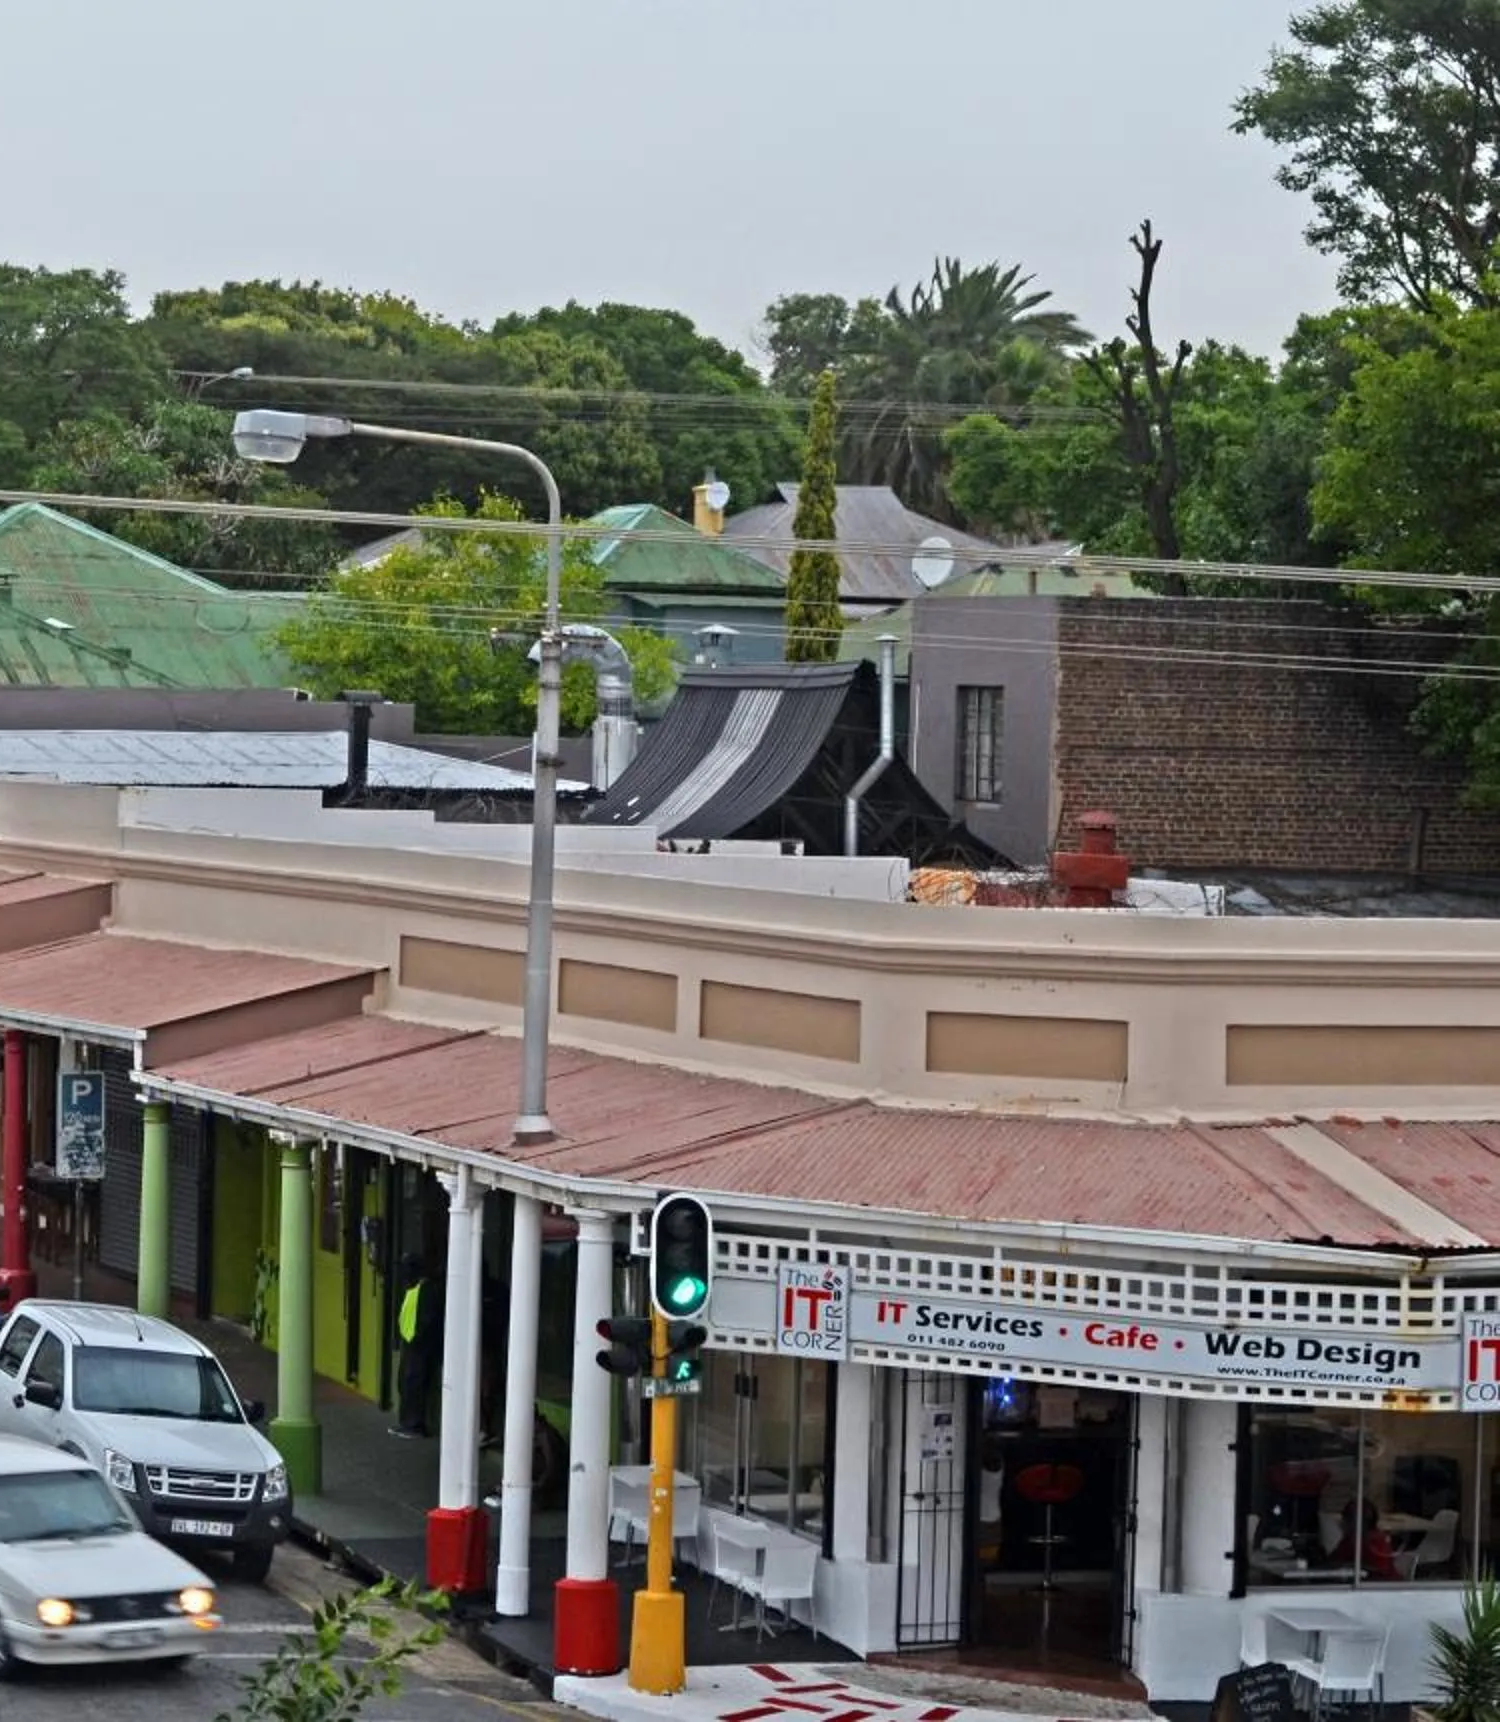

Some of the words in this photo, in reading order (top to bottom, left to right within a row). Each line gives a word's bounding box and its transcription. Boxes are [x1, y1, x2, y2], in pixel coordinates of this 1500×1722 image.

[72, 1080, 93, 1105] P
[785, 1269, 819, 1288] The
[784, 1288, 832, 1330] IT
[877, 1302, 908, 1323] IT
[915, 1305, 1044, 1337] Services
[1085, 1322, 1159, 1350] Cafe
[1205, 1333, 1285, 1359] Web
[1297, 1338, 1421, 1373] Design
[1217, 1365, 1406, 1385] www.TheITCorner.co.za
